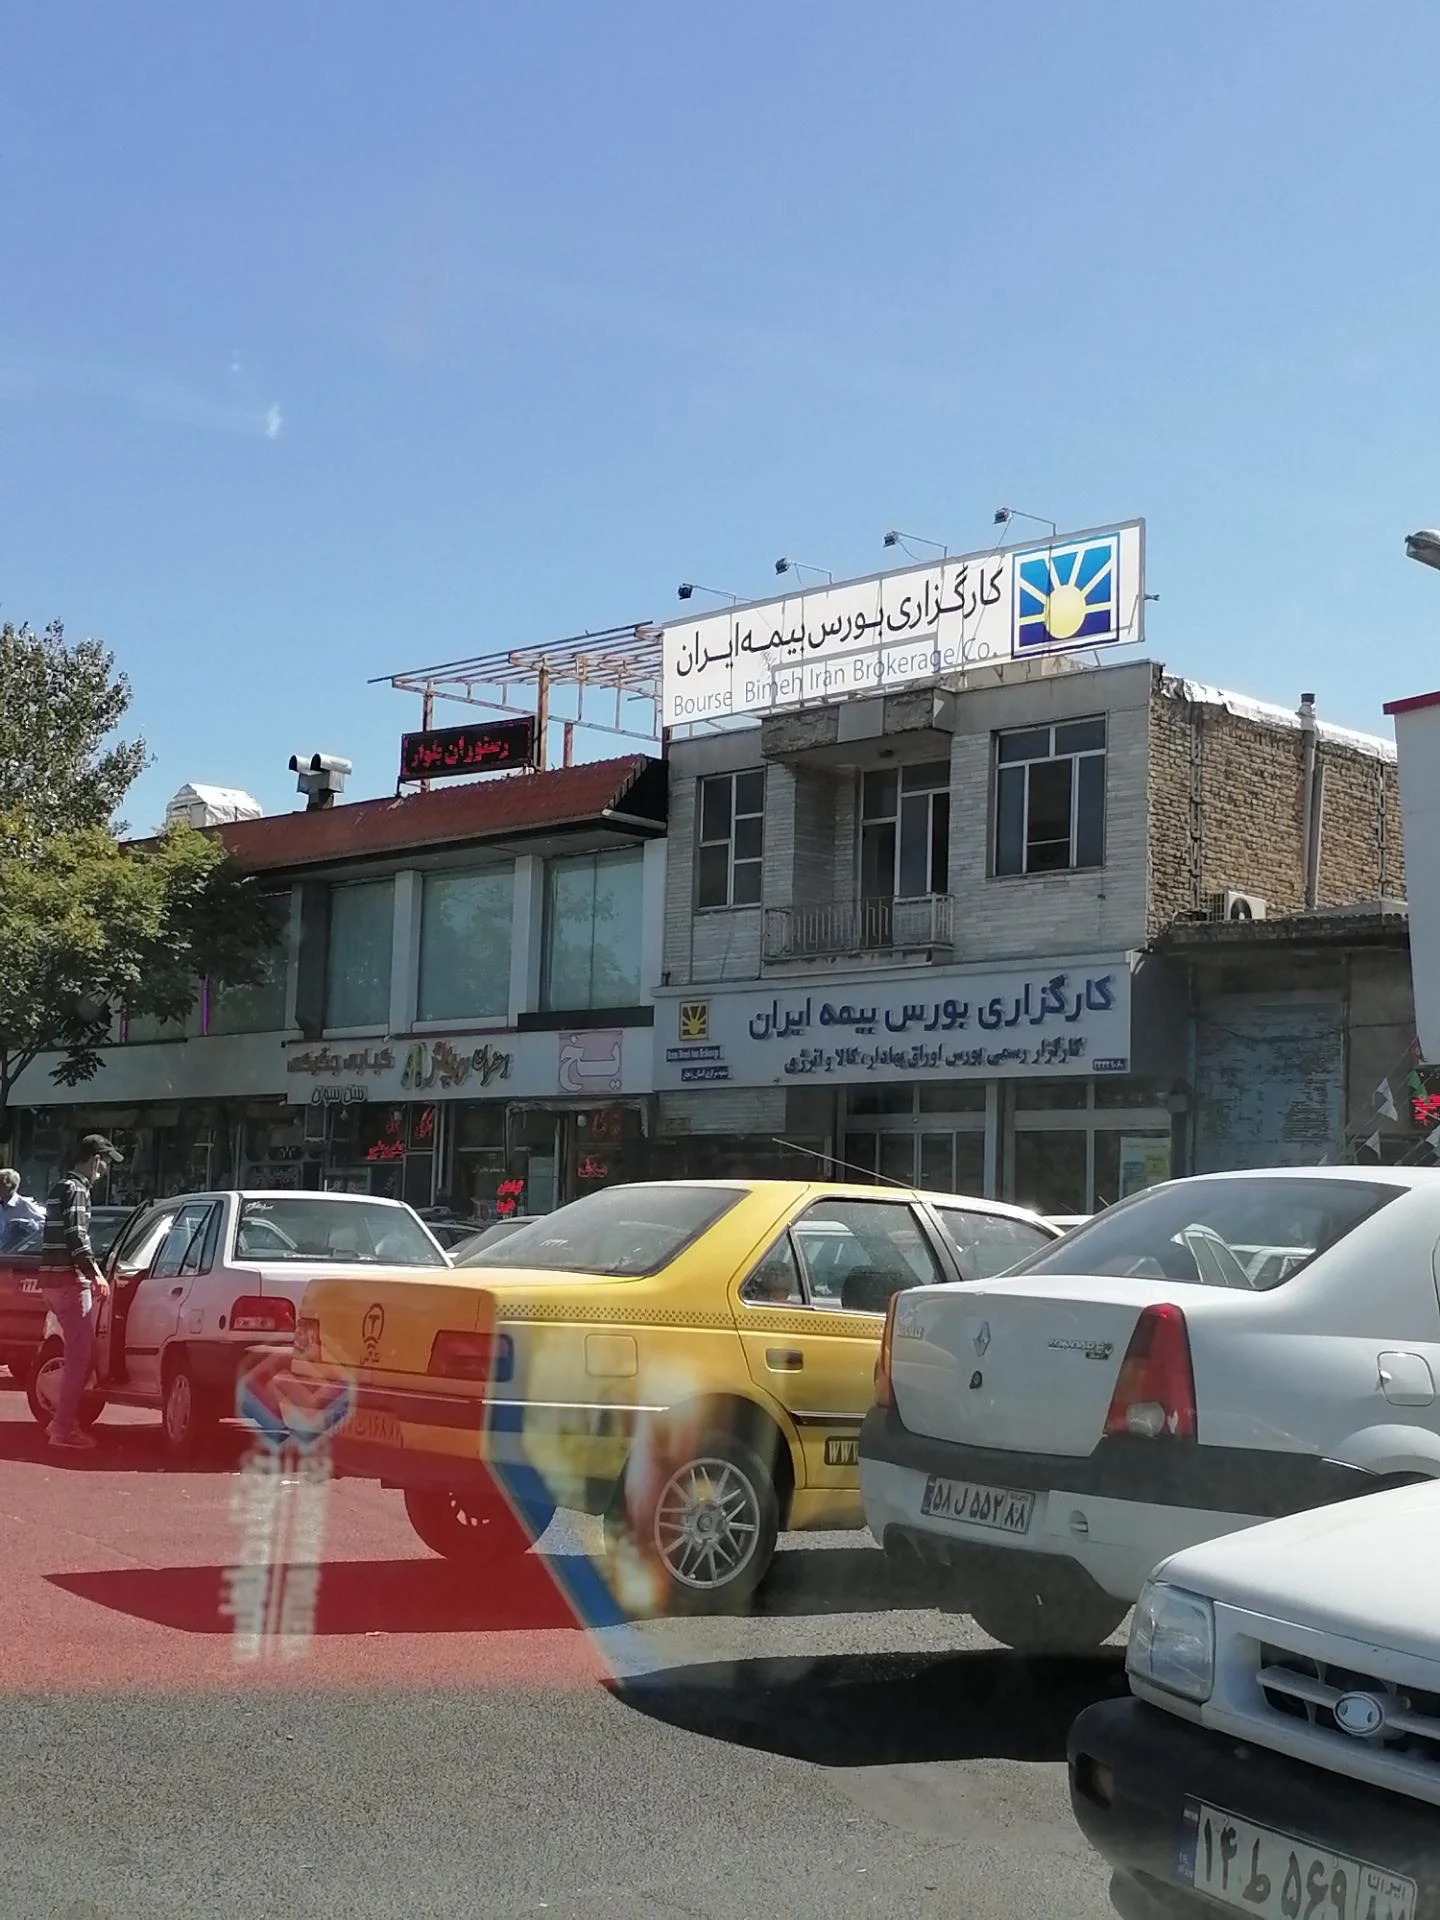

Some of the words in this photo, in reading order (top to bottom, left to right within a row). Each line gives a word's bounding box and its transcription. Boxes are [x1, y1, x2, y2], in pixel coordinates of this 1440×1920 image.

[886, 565, 1003, 632] کارگزاری
[741, 622, 805, 656] بیمه
[808, 606, 884, 649] بورس
[676, 621, 739, 677] ایران
[673, 690, 733, 717] Bourse
[745, 671, 802, 703] Bimeh
[809, 667, 846, 690] Iran
[853, 648, 955, 682] Brokerage
[962, 637, 998, 663] Co.
[749, 997, 813, 1041] ایران
[819, 1002, 877, 1035] بیمه
[884, 998, 969, 1033] بورس
[977, 974, 1114, 1030] کارگزاری
[835, 1046, 858, 1067] کالا
[907, 1043, 943, 1069] اوراق
[945, 1047, 984, 1067] بورس
[986, 1047, 1028, 1066] رسمی
[1366, 1871, 1407, 1902] ایران
